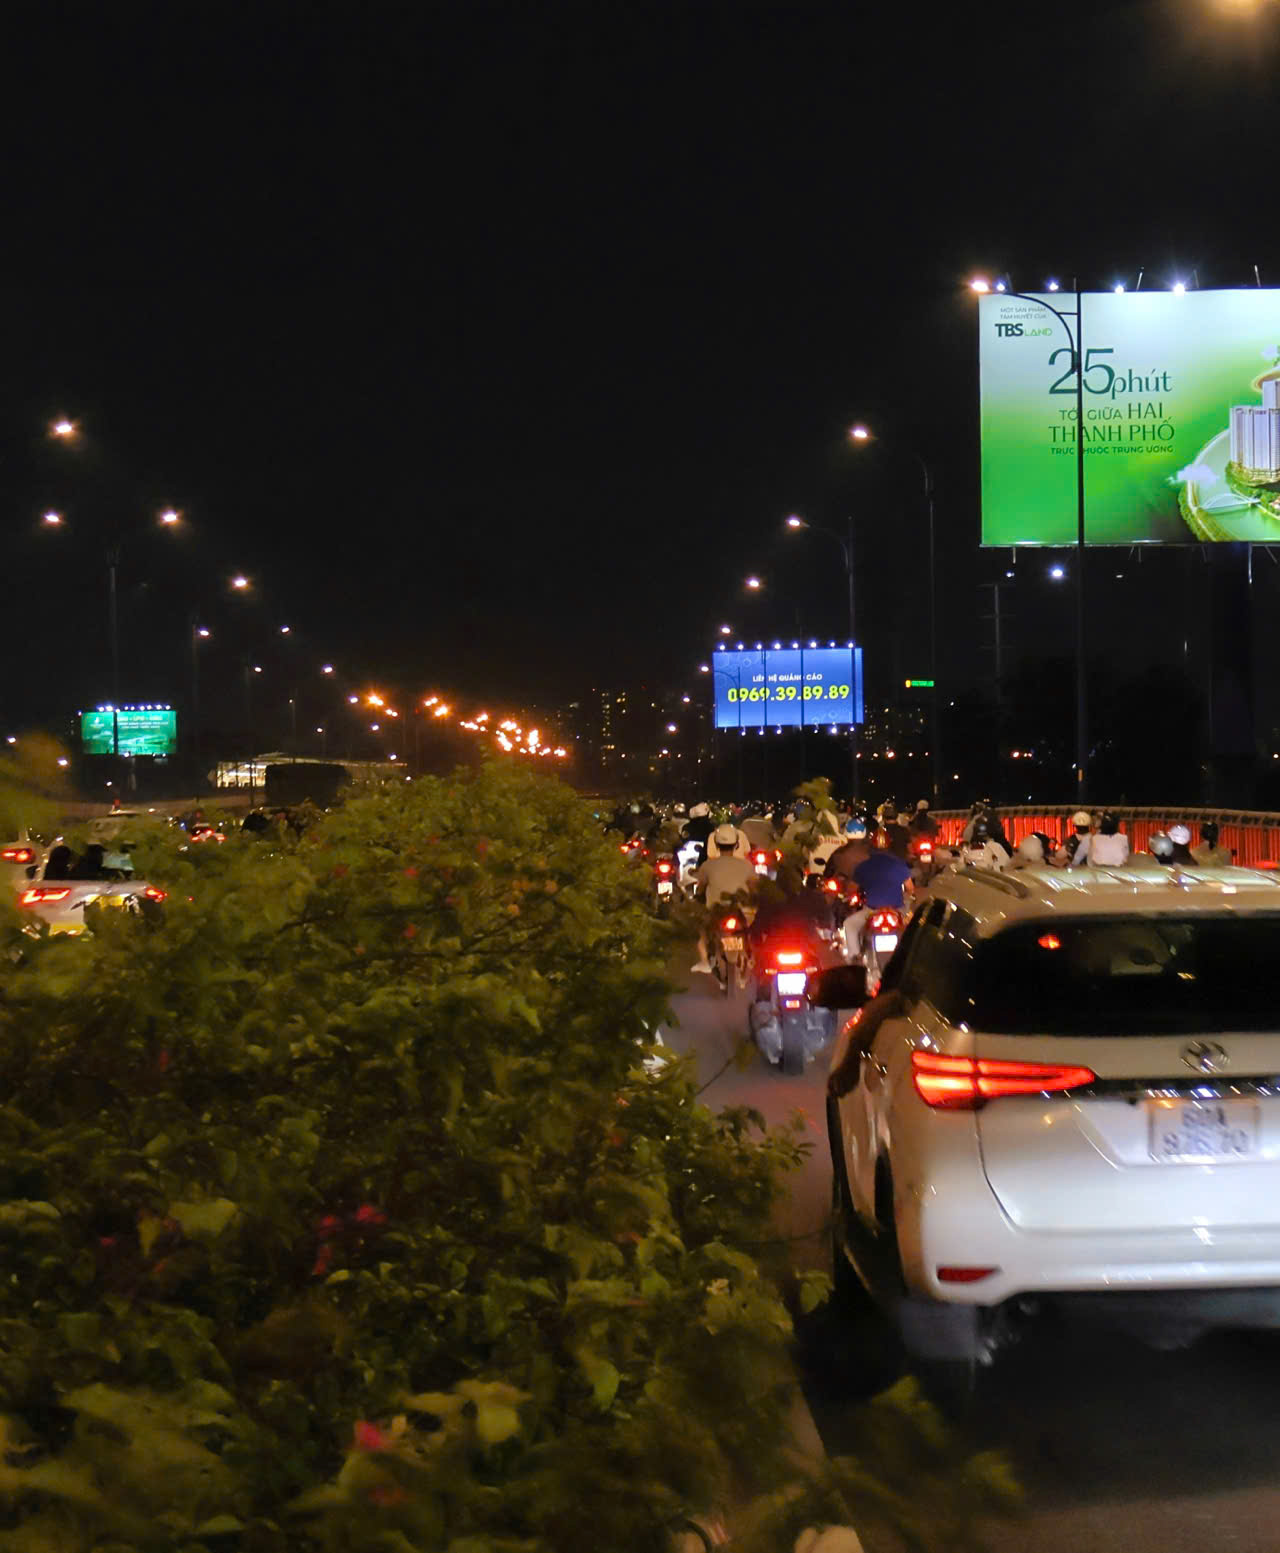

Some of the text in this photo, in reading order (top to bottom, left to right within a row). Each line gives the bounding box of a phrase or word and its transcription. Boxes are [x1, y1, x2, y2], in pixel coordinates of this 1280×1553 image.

[995, 323, 1052, 337] TBS LAND
[1112, 368, 1172, 400] phút
[1059, 402, 1163, 421] TỚ GIỮA HAI
[1129, 416, 1175, 441] PHỐ
[1077, 446, 1109, 455] HUỘC
[1112, 446, 1144, 454] TRUNG
[727, 684, 850, 703] 0969.39.89.89
